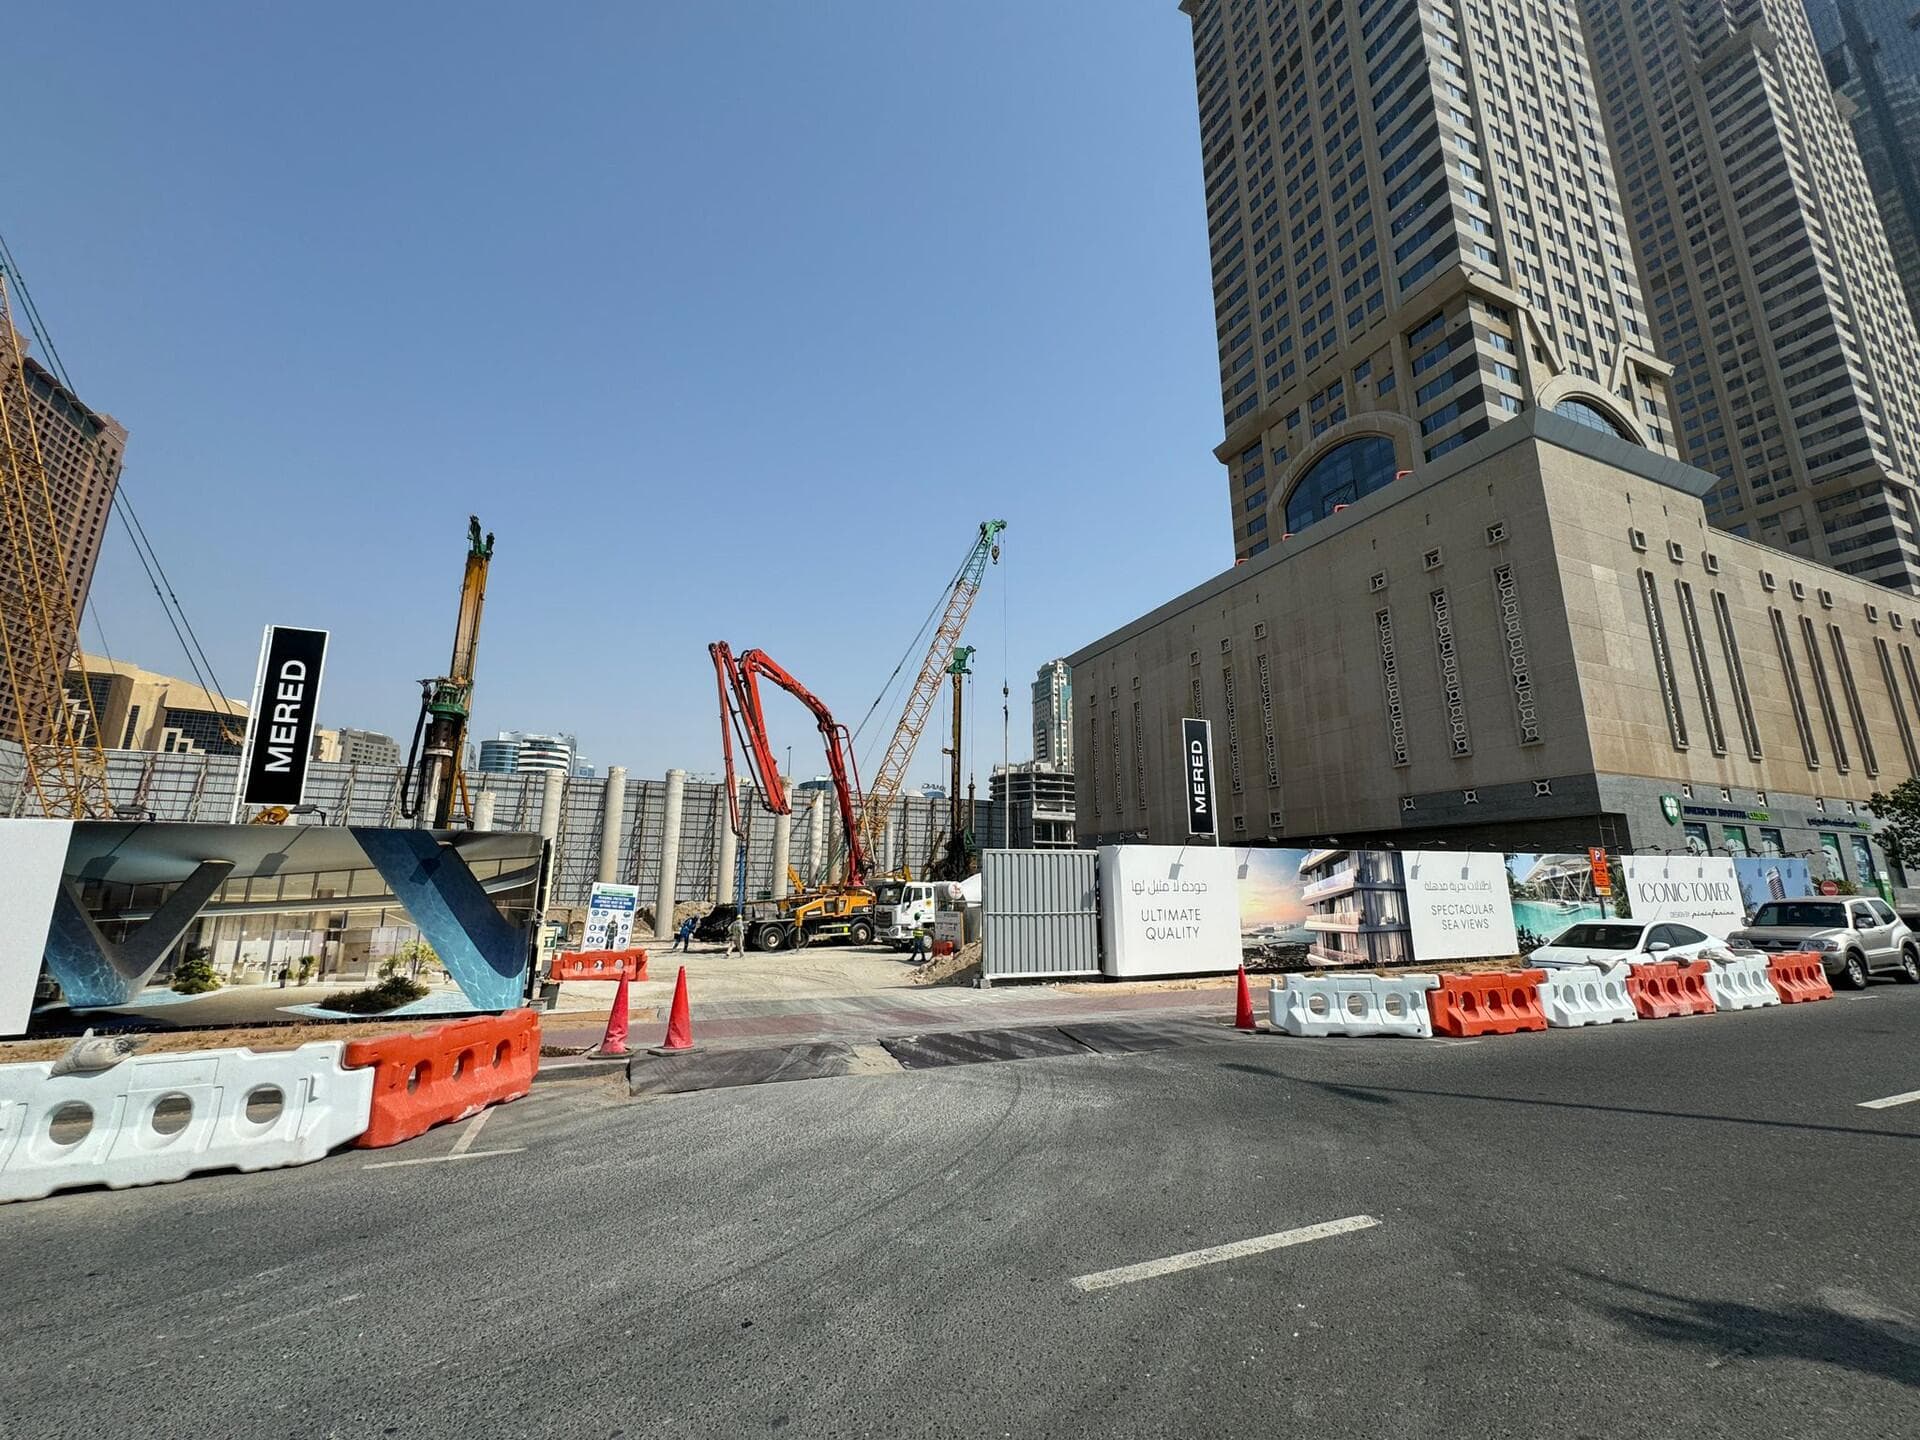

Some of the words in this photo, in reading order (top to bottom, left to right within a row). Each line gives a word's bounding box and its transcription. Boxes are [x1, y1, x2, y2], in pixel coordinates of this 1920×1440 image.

[264, 659, 307, 773] MERED
[1191, 740, 1207, 814] MERED
[1131, 880, 1145, 896] لها
[1638, 881, 1690, 903] ICONIC
[1689, 881, 1732, 902] TOWER
[1141, 908, 1201, 922] ULTIMATE
[1431, 904, 1494, 916] SPECTACULAR
[1442, 919, 1460, 931] SEA
[1461, 918, 1490, 930] VIEWS
[1145, 926, 1200, 942] QUALITY
